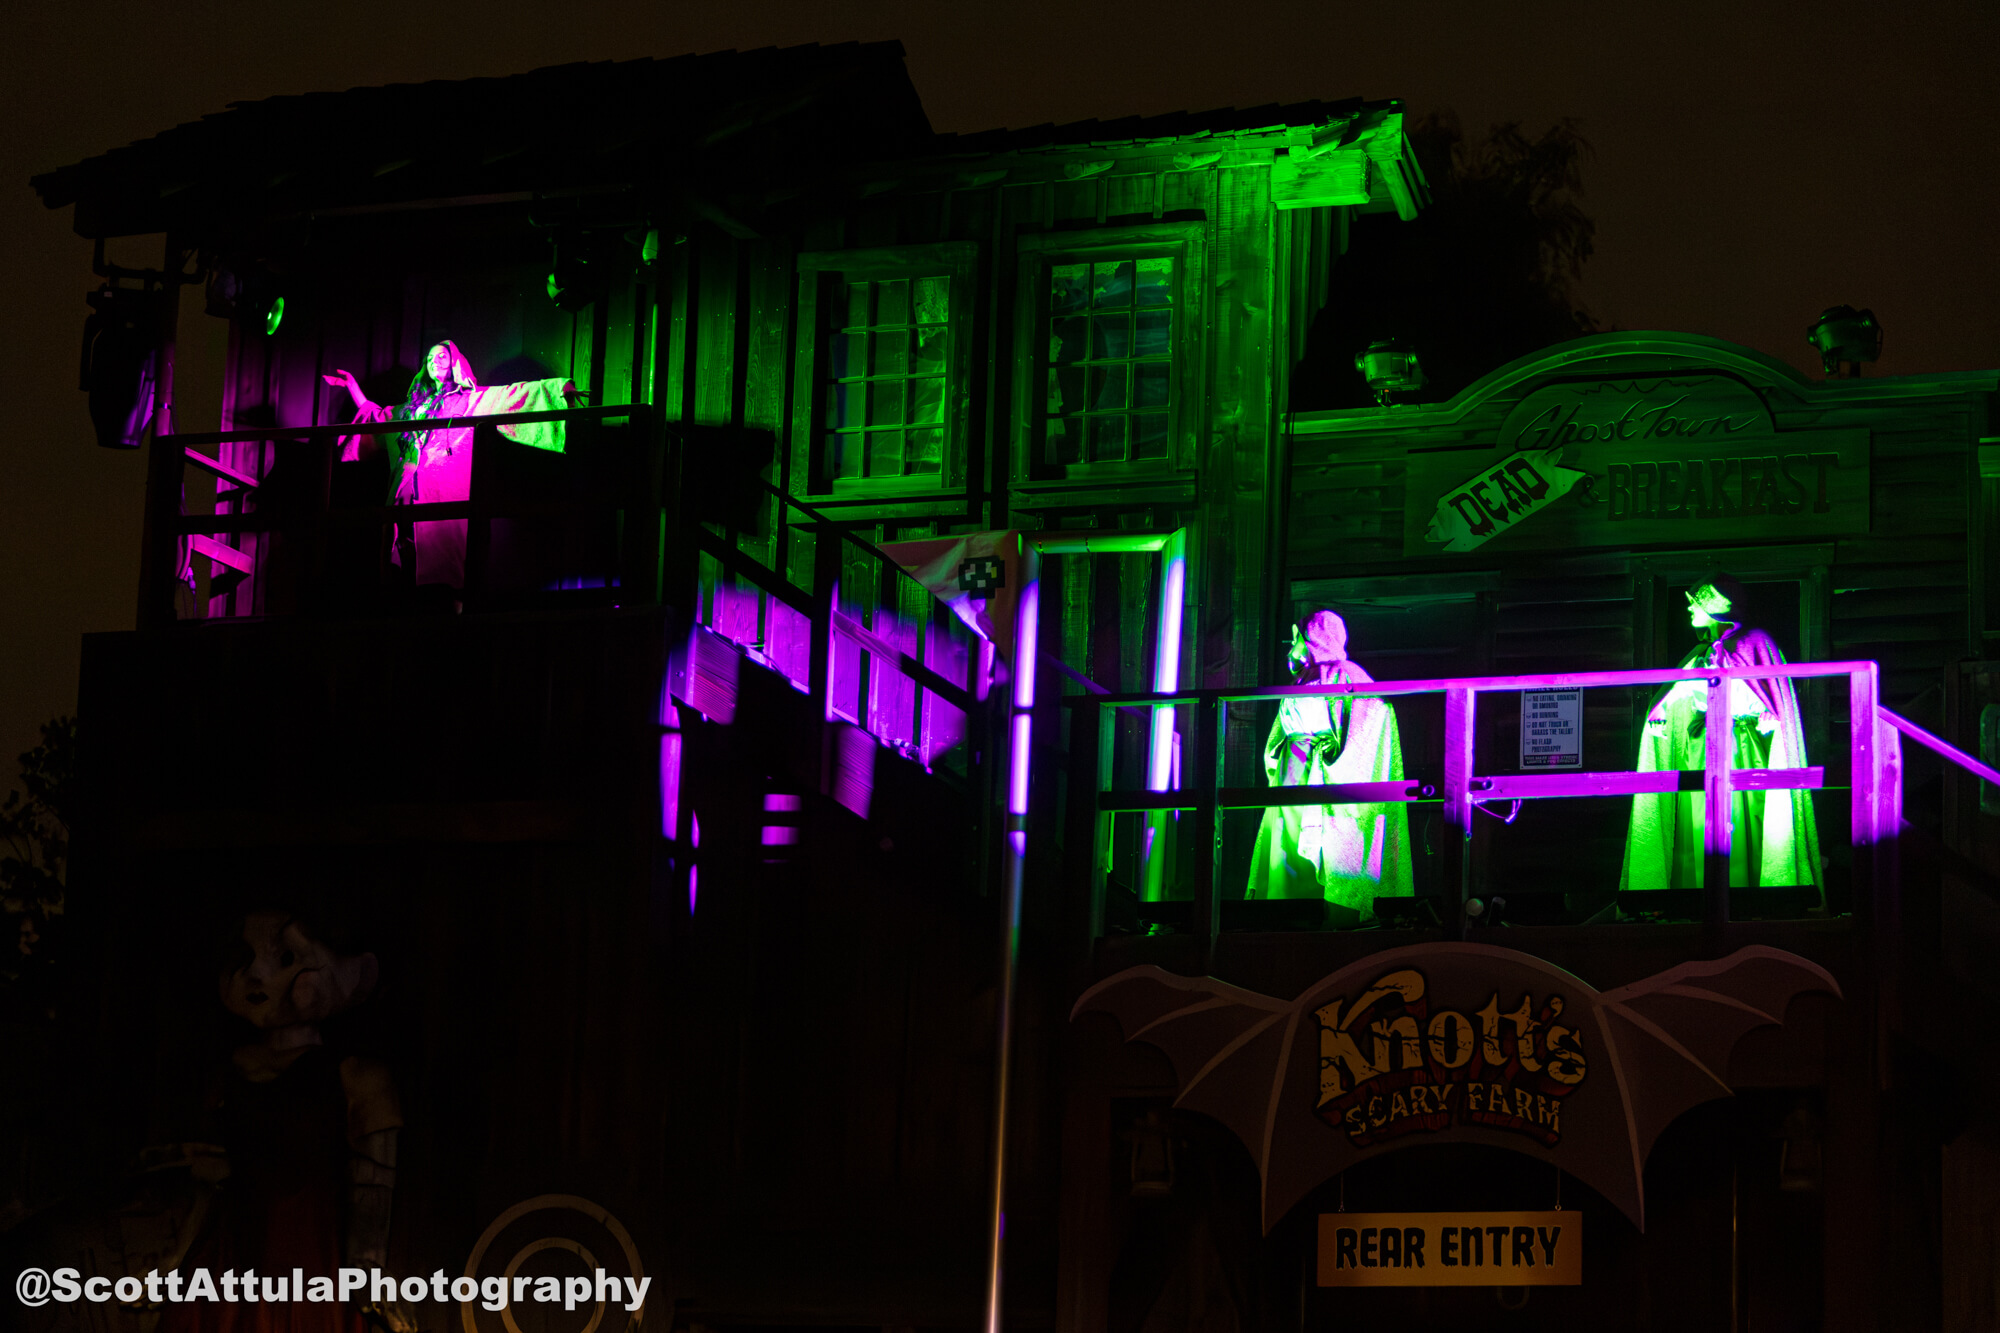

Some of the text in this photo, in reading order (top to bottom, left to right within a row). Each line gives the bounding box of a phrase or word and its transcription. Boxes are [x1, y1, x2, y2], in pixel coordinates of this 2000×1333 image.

[1513, 394, 1760, 451] Ghost Town
[1447, 457, 1550, 538] DEAD
[1608, 452, 1840, 521] BREAKFAST
[1311, 968, 1588, 1109] Knott's
[1344, 1082, 1562, 1137] SCARY FARM
[1335, 1226, 1562, 1269] REAR ENTRY
